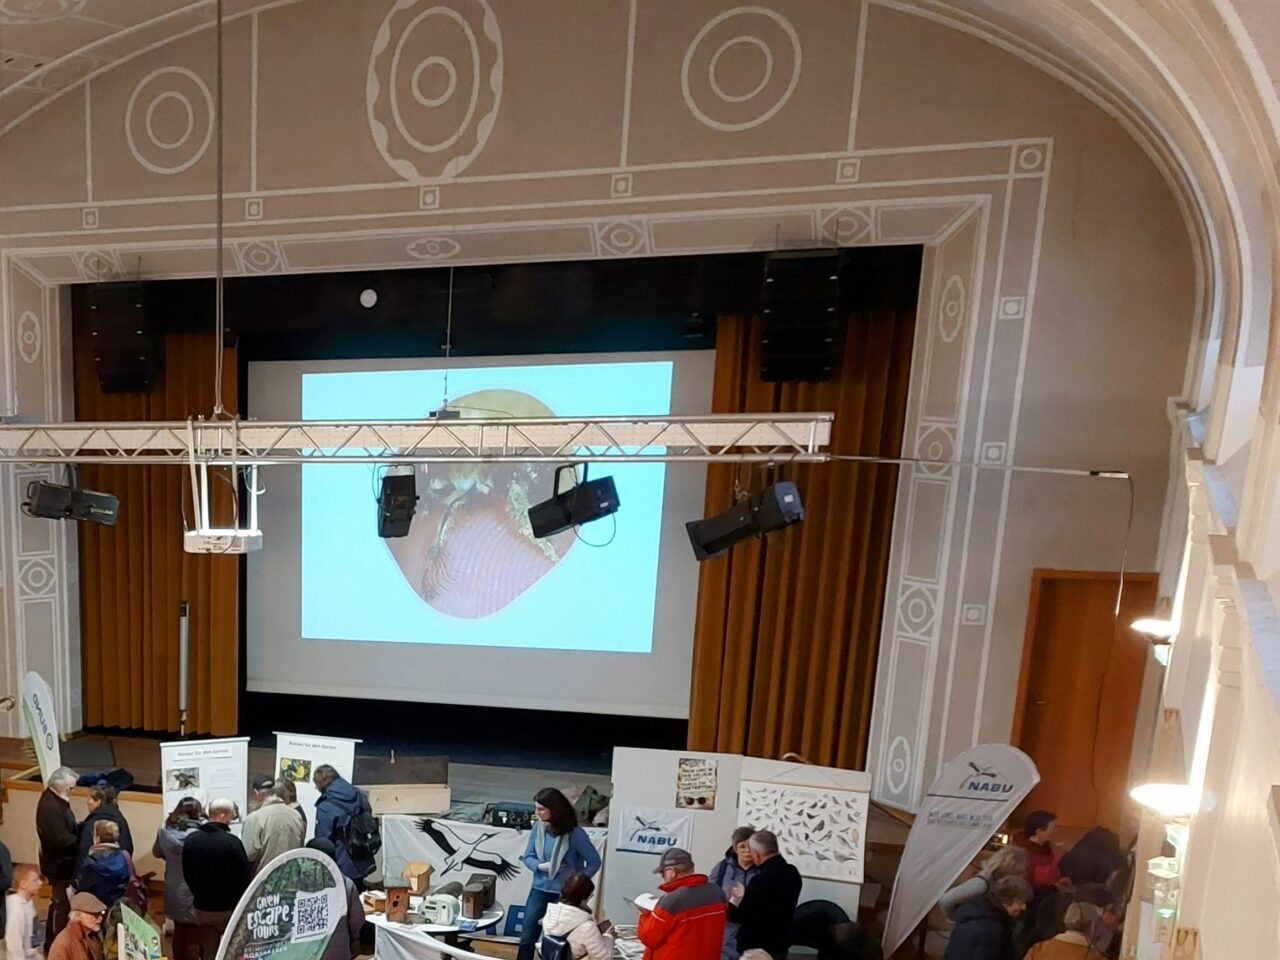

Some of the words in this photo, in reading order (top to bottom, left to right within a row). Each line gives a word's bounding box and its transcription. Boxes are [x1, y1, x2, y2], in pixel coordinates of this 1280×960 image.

[968, 781, 1014, 793] NABU
[637, 835, 678, 846] NABU
[253, 925, 279, 939] TOURS
